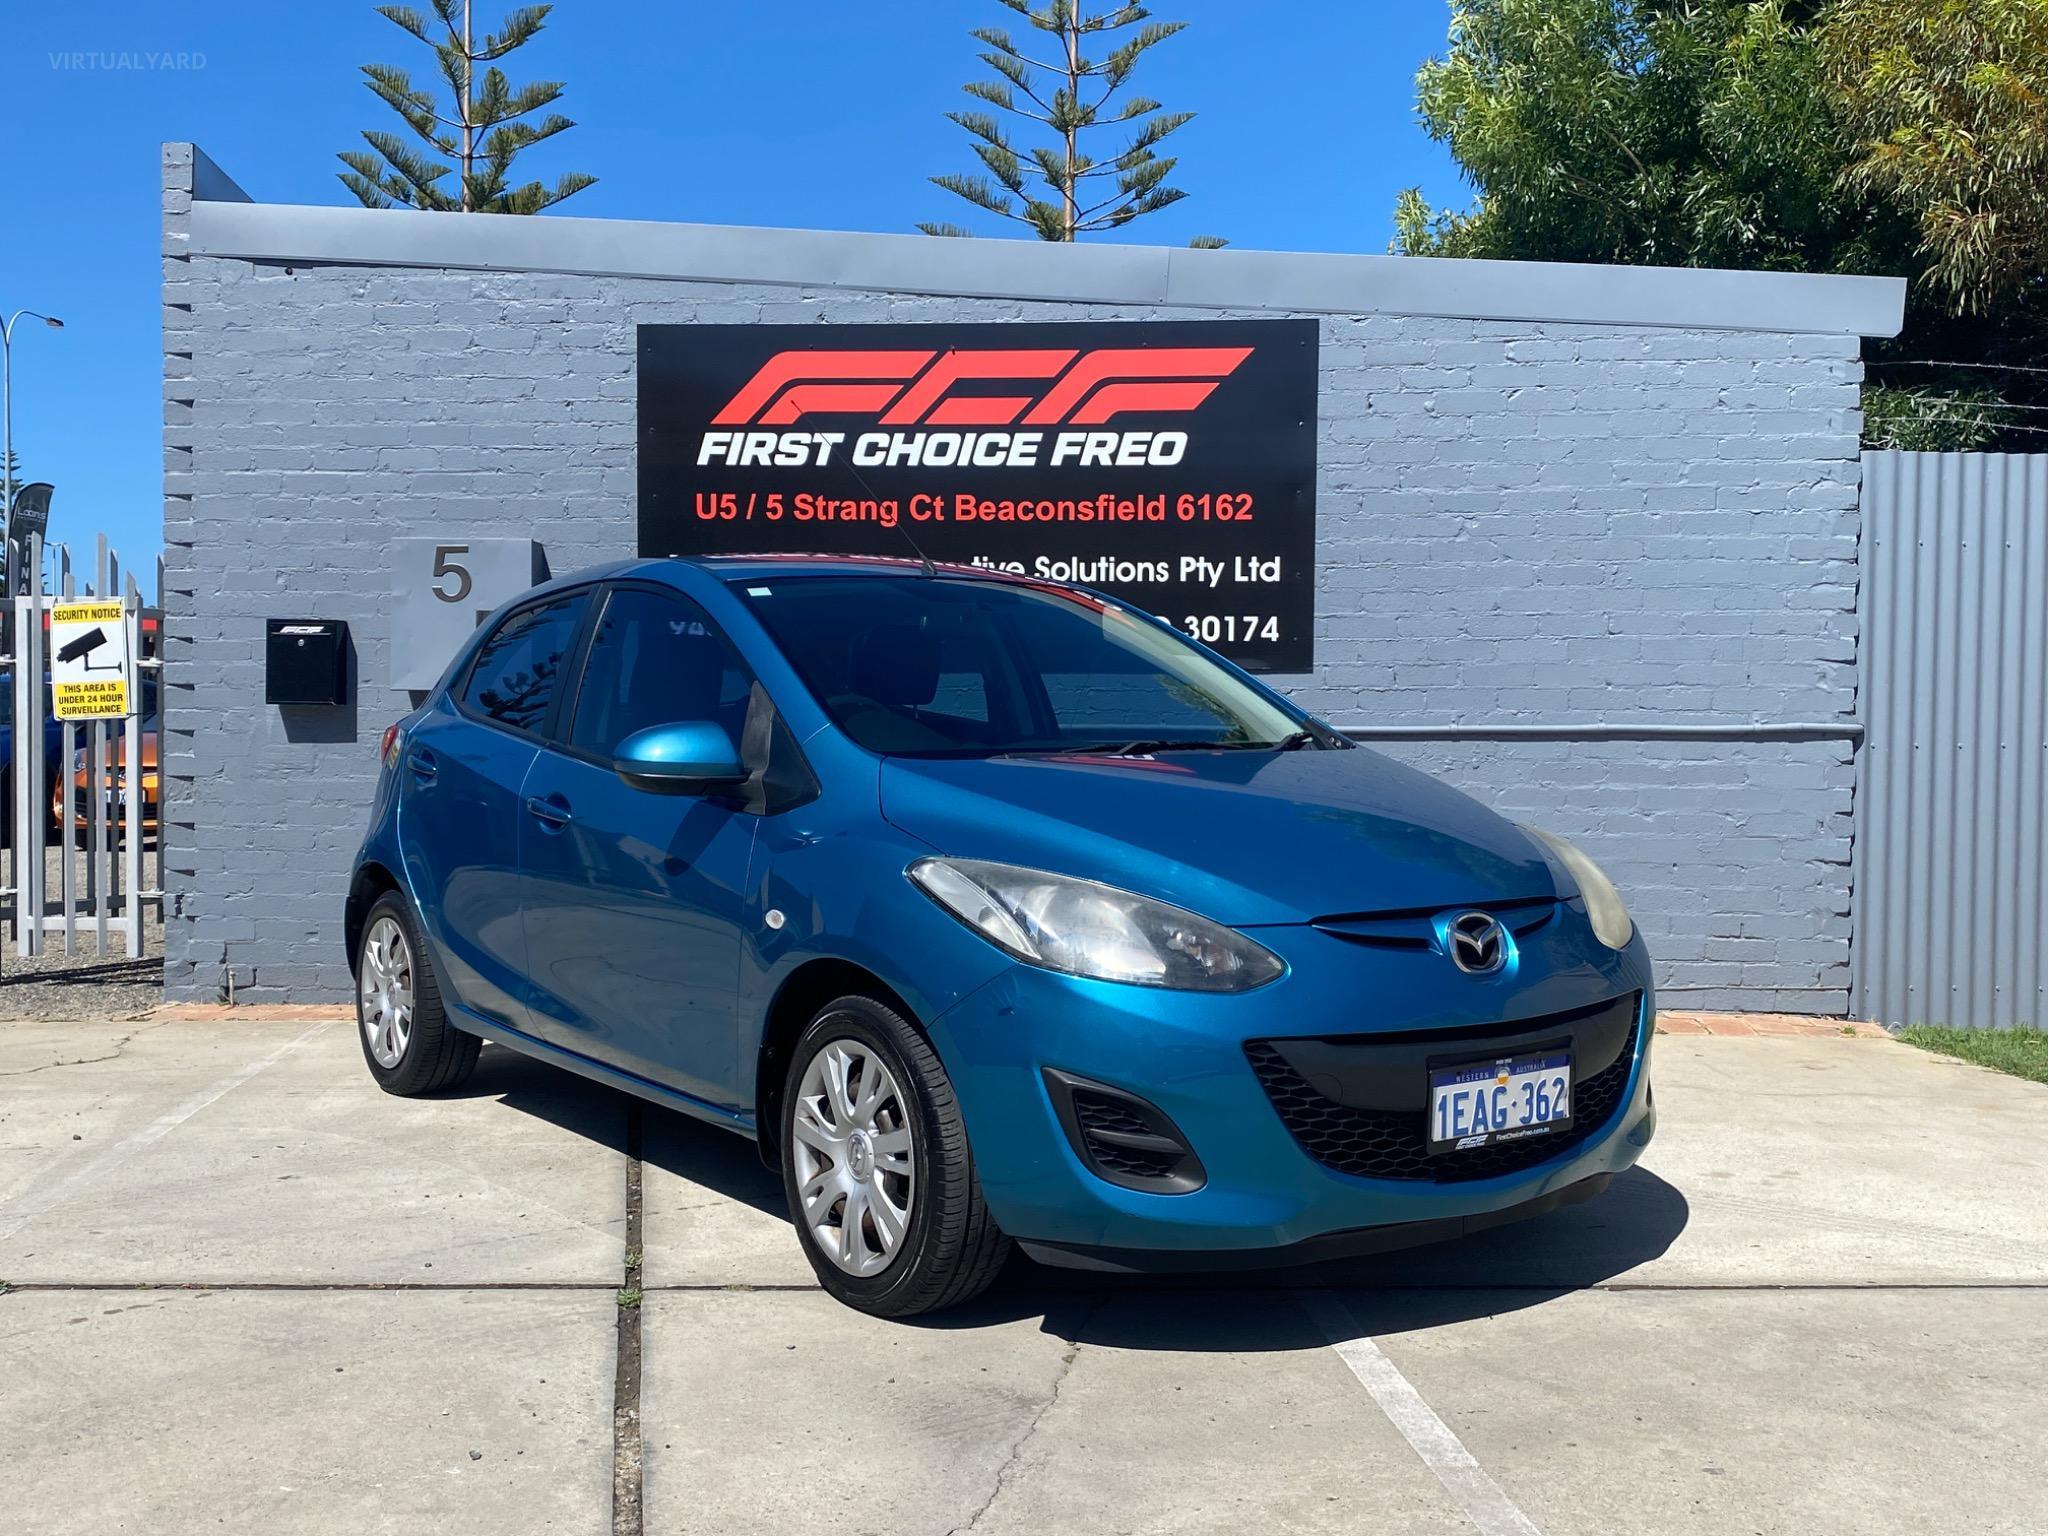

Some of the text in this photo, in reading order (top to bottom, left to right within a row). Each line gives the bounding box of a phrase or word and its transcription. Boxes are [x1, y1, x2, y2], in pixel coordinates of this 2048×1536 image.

[697, 431, 1188, 467] FIRST CHOICE FREO
[696, 493, 737, 520] U5
[765, 494, 783, 520] 5
[793, 494, 898, 527] Strang
[909, 494, 944, 521] Ct
[955, 494, 1165, 521] Beaconsfield
[1177, 494, 1253, 521] 6162
[432, 544, 472, 603] 5
[1034, 555, 1169, 582] Solutions
[1179, 556, 1224, 587] Pty
[1235, 556, 1280, 582] Ltd
[53, 607, 121, 621] SECURITY NOTICE
[1184, 615, 1279, 642] 30174
[58, 694, 123, 704] UNDER 24 HOUR
[64, 683, 117, 693] THIS AREA IS
[61, 704, 121, 715] SURVEILLANCE
[1456, 1071, 1490, 1083] WESTERN
[1516, 1059, 1546, 1073] AUSTRALIA
